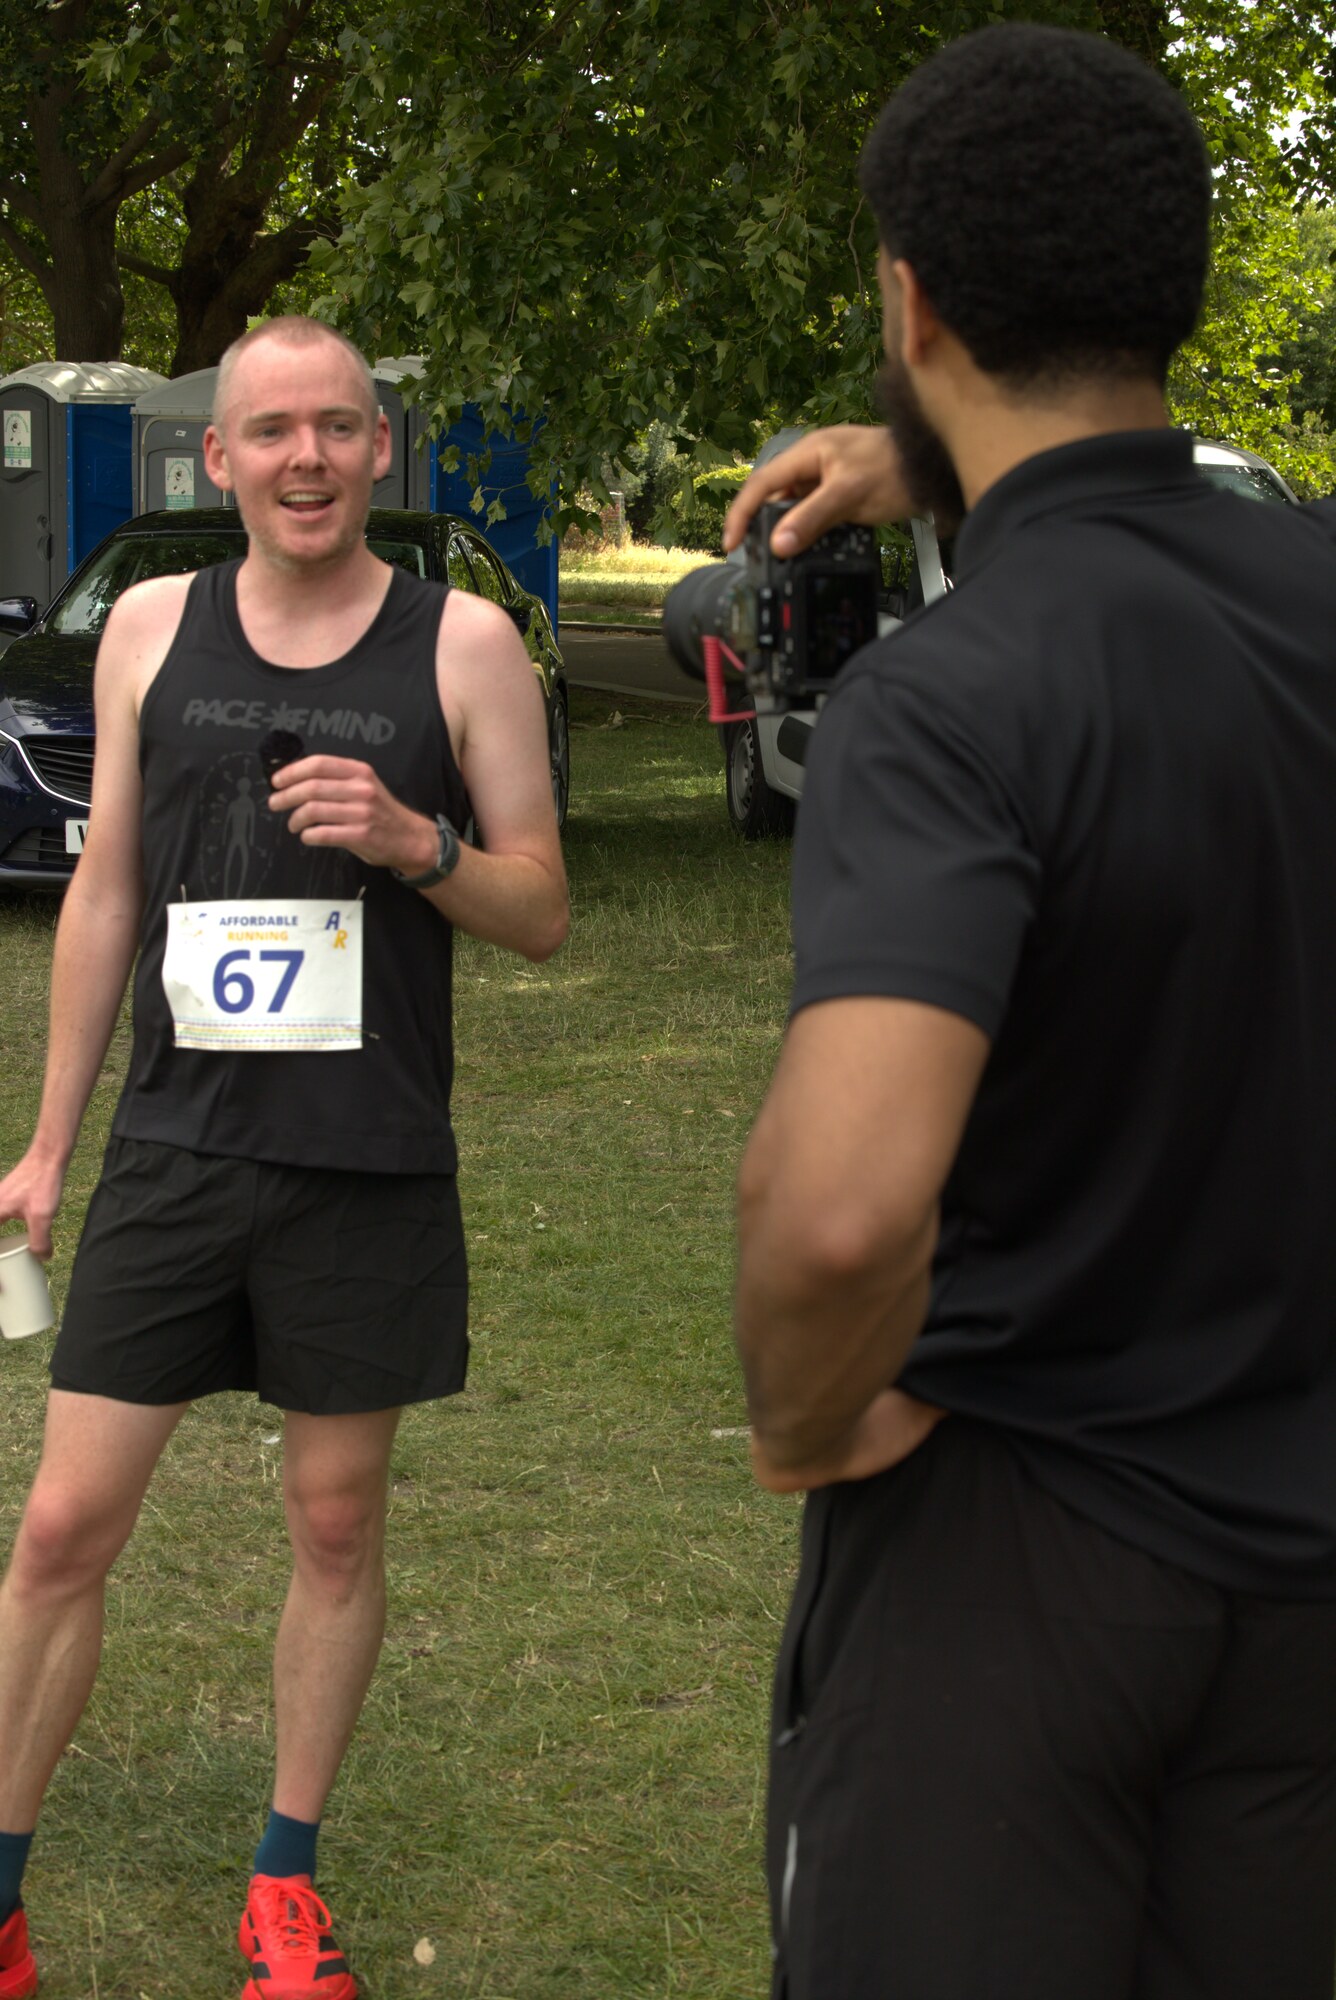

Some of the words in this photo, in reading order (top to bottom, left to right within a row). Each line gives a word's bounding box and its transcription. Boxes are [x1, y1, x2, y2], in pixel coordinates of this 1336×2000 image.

[182, 698, 267, 731] PACE
[307, 707, 397, 746] MIND
[219, 915, 299, 927] AFFORDABLE
[227, 931, 290, 942] RUNNING
[212, 949, 306, 1014] 67
